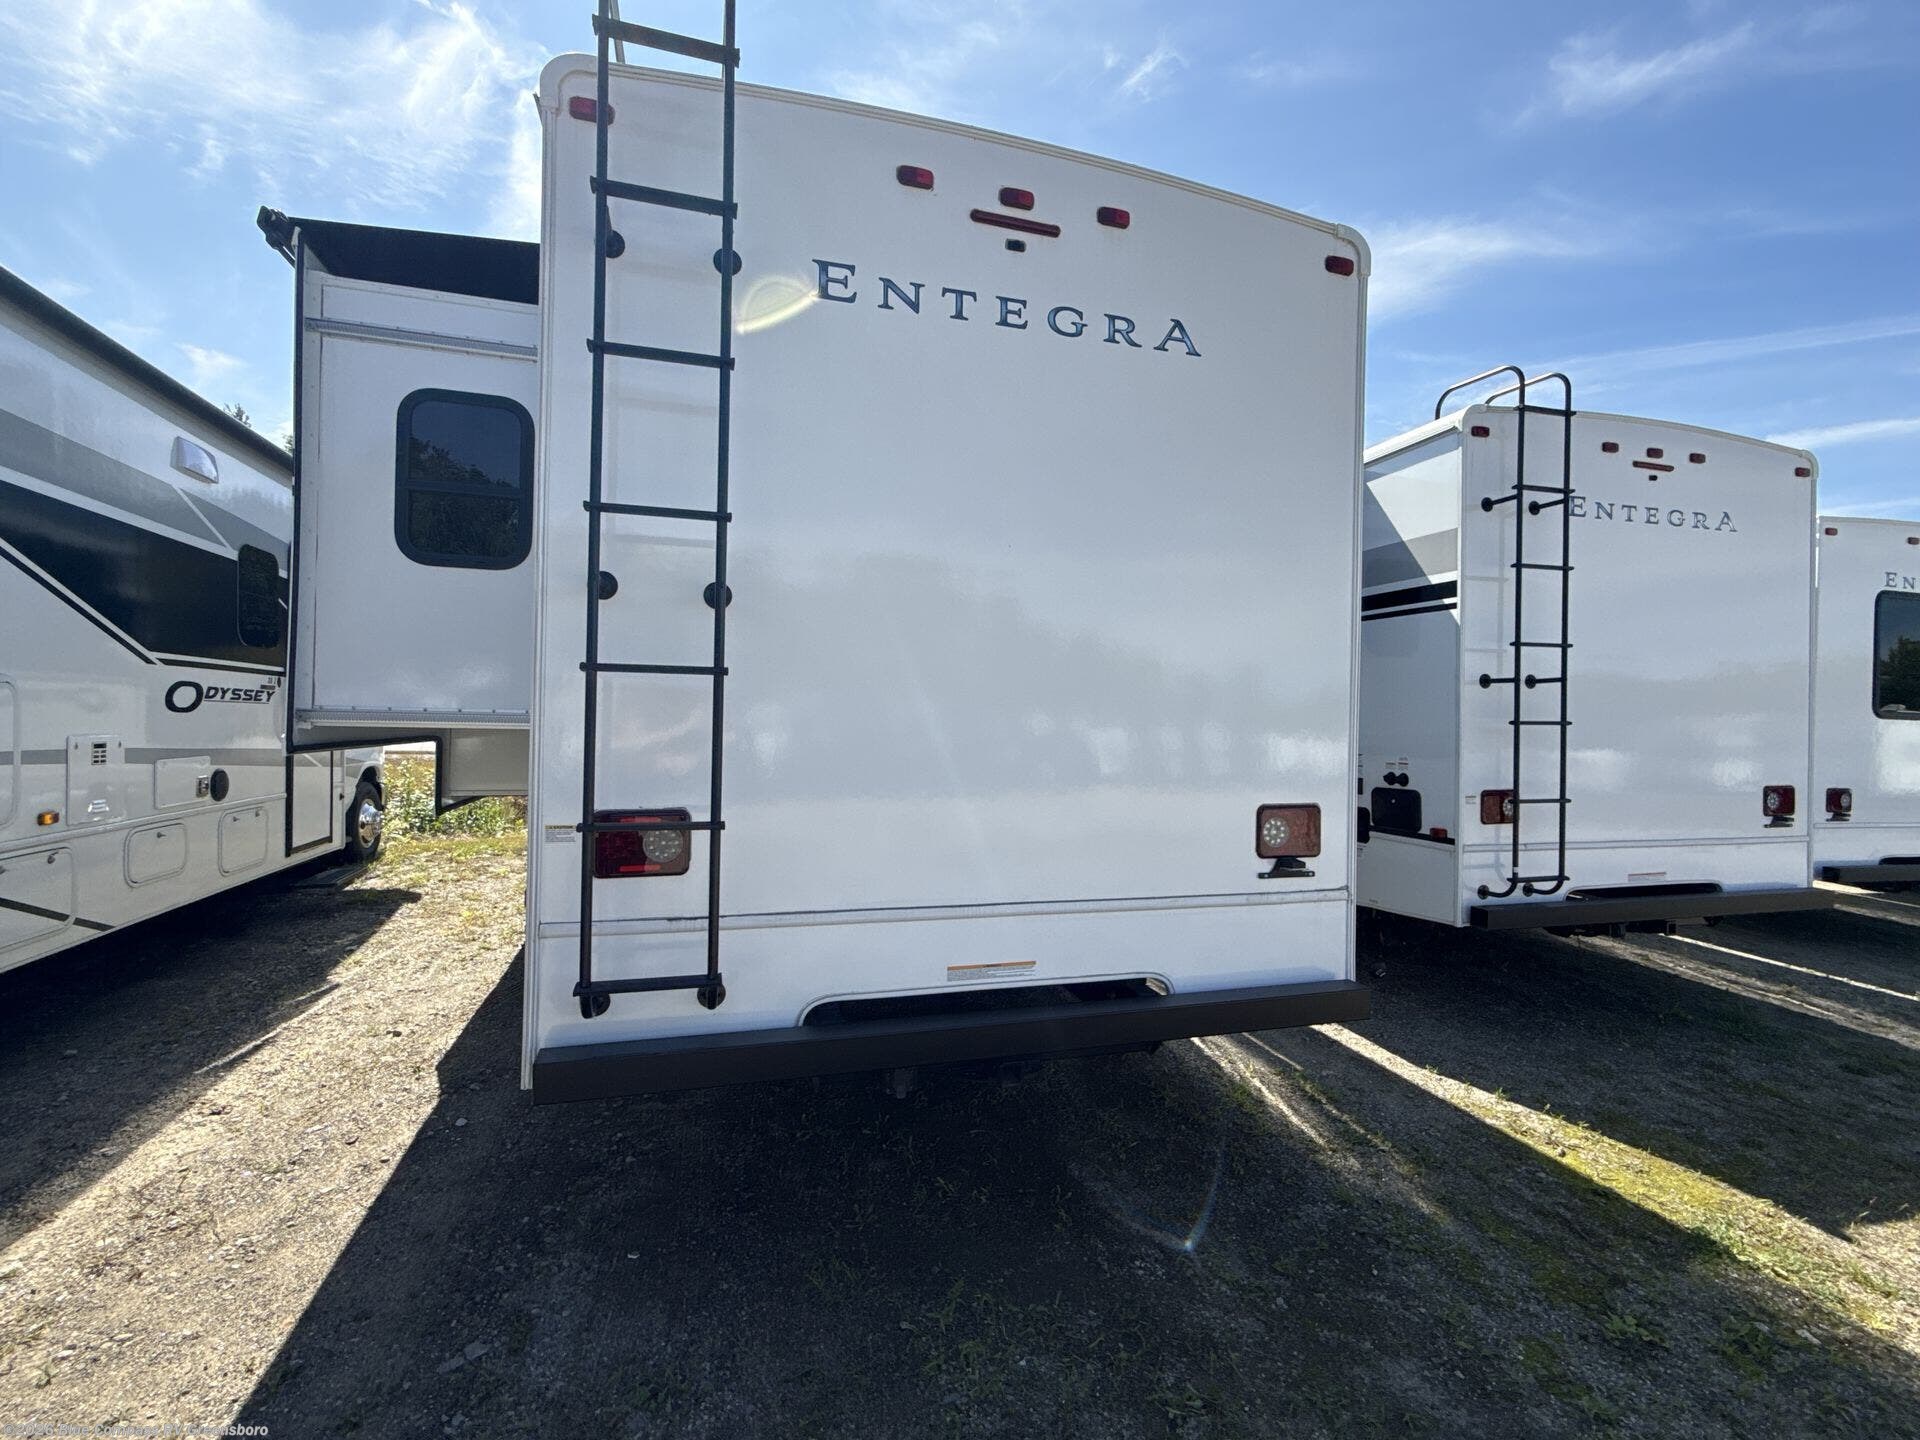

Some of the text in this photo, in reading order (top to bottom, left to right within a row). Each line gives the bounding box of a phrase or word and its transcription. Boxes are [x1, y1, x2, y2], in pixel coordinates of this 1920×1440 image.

[812, 259, 1202, 357] ENTEGRA
[1569, 495, 1738, 532] ENTEGRA
[165, 681, 275, 713] ODYSSEY
